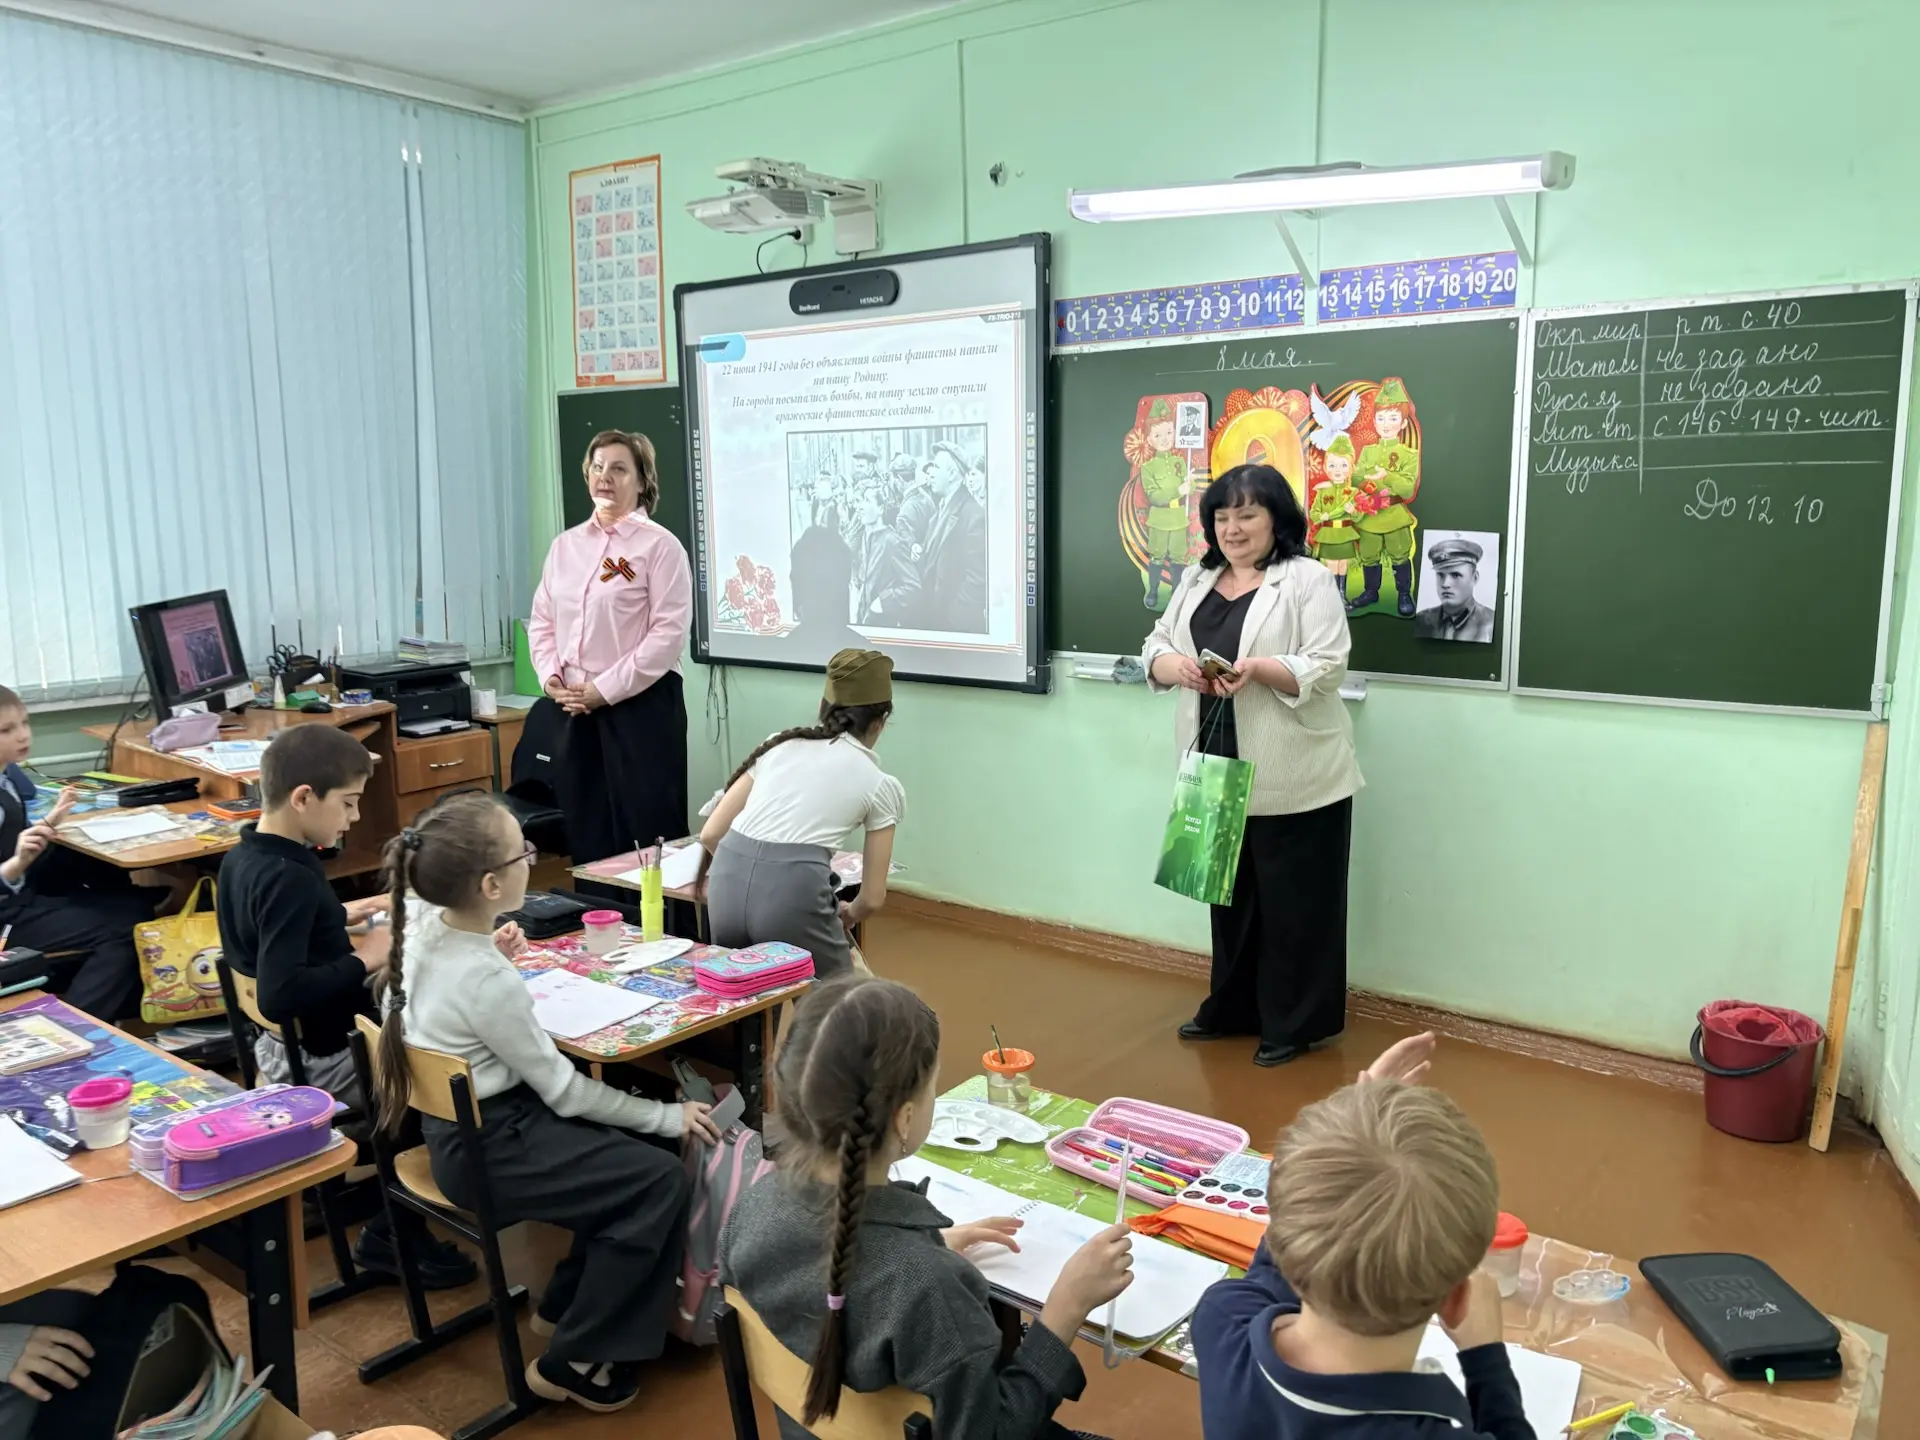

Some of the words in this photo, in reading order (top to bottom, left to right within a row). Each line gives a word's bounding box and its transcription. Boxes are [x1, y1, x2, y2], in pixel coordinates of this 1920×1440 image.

[1319, 285, 1339, 308] 13
[1342, 282, 1362, 306] 14
[1365, 280, 1385, 303] 15
[1389, 277, 1410, 301] 16
[1414, 275, 1436, 299] 17
[1440, 272, 1461, 297] 18
[1465, 270, 1487, 295] 19
[1490, 267, 1516, 293] 20
[1066, 311, 1076, 333] 0
[1082, 309, 1090, 331] 1
[1097, 307, 1108, 330] 2
[1114, 306, 1125, 328] 3
[1130, 303, 1142, 326] 4
[1148, 302, 1160, 325] 5
[1166, 300, 1178, 323] 6
[1183, 299, 1195, 322] 7
[1200, 297, 1212, 320] 8
[1219, 295, 1231, 318] 9
[1237, 292, 1260, 316] 10
[1265, 290, 1281, 313] 11
[1284, 289, 1304, 311] 12
[1767, 302, 1800, 327] 40
[722, 364, 732, 376] 22
[733, 365, 756, 376] июня
[758, 361, 777, 374] 1941
[779, 361, 800, 372] года
[800, 358, 814, 370] без
[816, 355, 870, 368] объявления
[872, 351, 902, 364] войны
[904, 348, 957, 364] фашисты
[959, 344, 998, 356] напали
[1593, 323, 1640, 365] мир
[732, 396, 744, 407] На
[746, 395, 774, 408] города
[775, 394, 828, 405] посыпались
[865, 390, 877, 400] на
[879, 388, 905, 400] нашу
[907, 386, 938, 397] землю
[941, 382, 987, 396] ступили
[813, 376, 825, 386] на
[826, 375, 851, 386] нашу
[1661, 382, 1686, 402] не
[1693, 375, 1822, 419] задано
[825, 407, 886, 423] фашистские
[1535, 445, 1638, 494] Музыка
[1684, 477, 1736, 520] До
[1747, 494, 1774, 524] 12
[1794, 494, 1824, 524] 10
